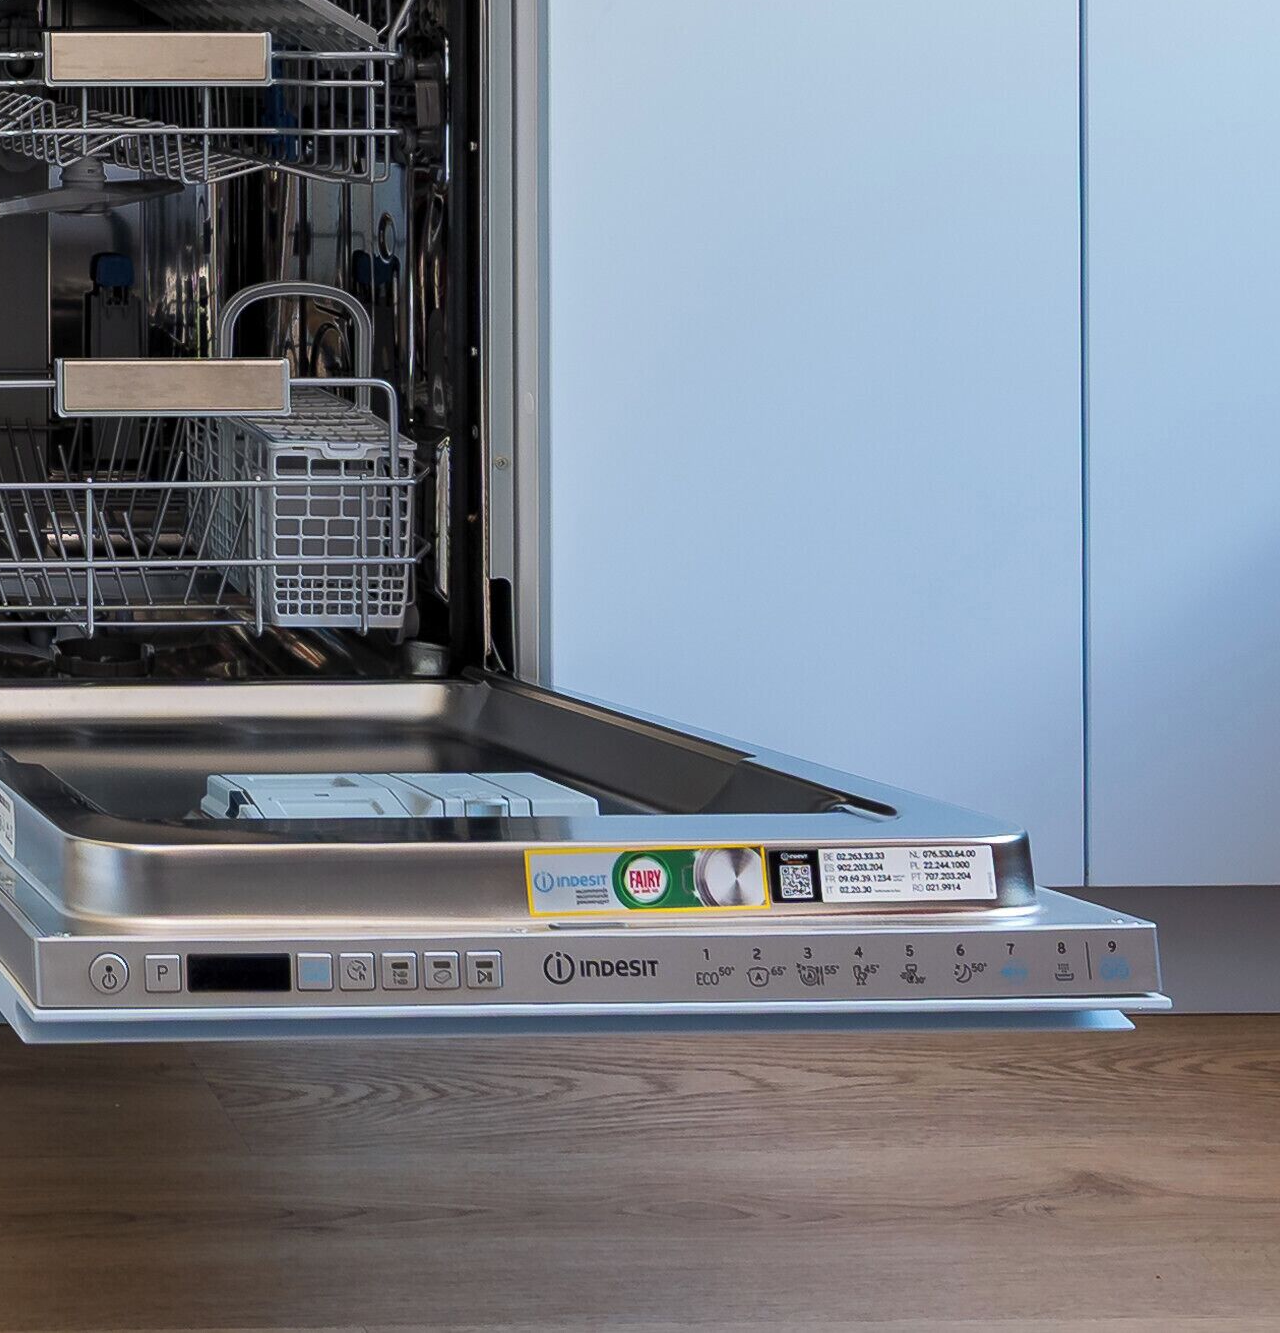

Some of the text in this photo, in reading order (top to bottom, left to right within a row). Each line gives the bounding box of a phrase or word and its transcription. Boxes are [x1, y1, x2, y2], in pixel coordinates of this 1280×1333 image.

[823, 853, 833, 861] BE
[909, 850, 920, 859] NL
[910, 862, 920, 870] PL
[629, 869, 661, 888] FAIRY
[825, 875, 836, 883] FR
[838, 874, 892, 883] 09.69.39.1234
[911, 873, 921, 881] PT
[826, 886, 834, 894] IT
[912, 884, 924, 892] RO
[854, 946, 863, 958] 4
[905, 944, 914, 957] 5
[955, 943, 965, 957] 6
[1006, 943, 1015, 956] 7
[1057, 942, 1066, 955] 8
[1107, 940, 1117, 953] 9
[702, 948, 710, 961] 1
[752, 948, 762, 961] 2
[803, 947, 813, 960] 3
[156, 964, 169, 982] P
[579, 959, 659, 977] INDESIT
[695, 971, 719, 986] ECO
